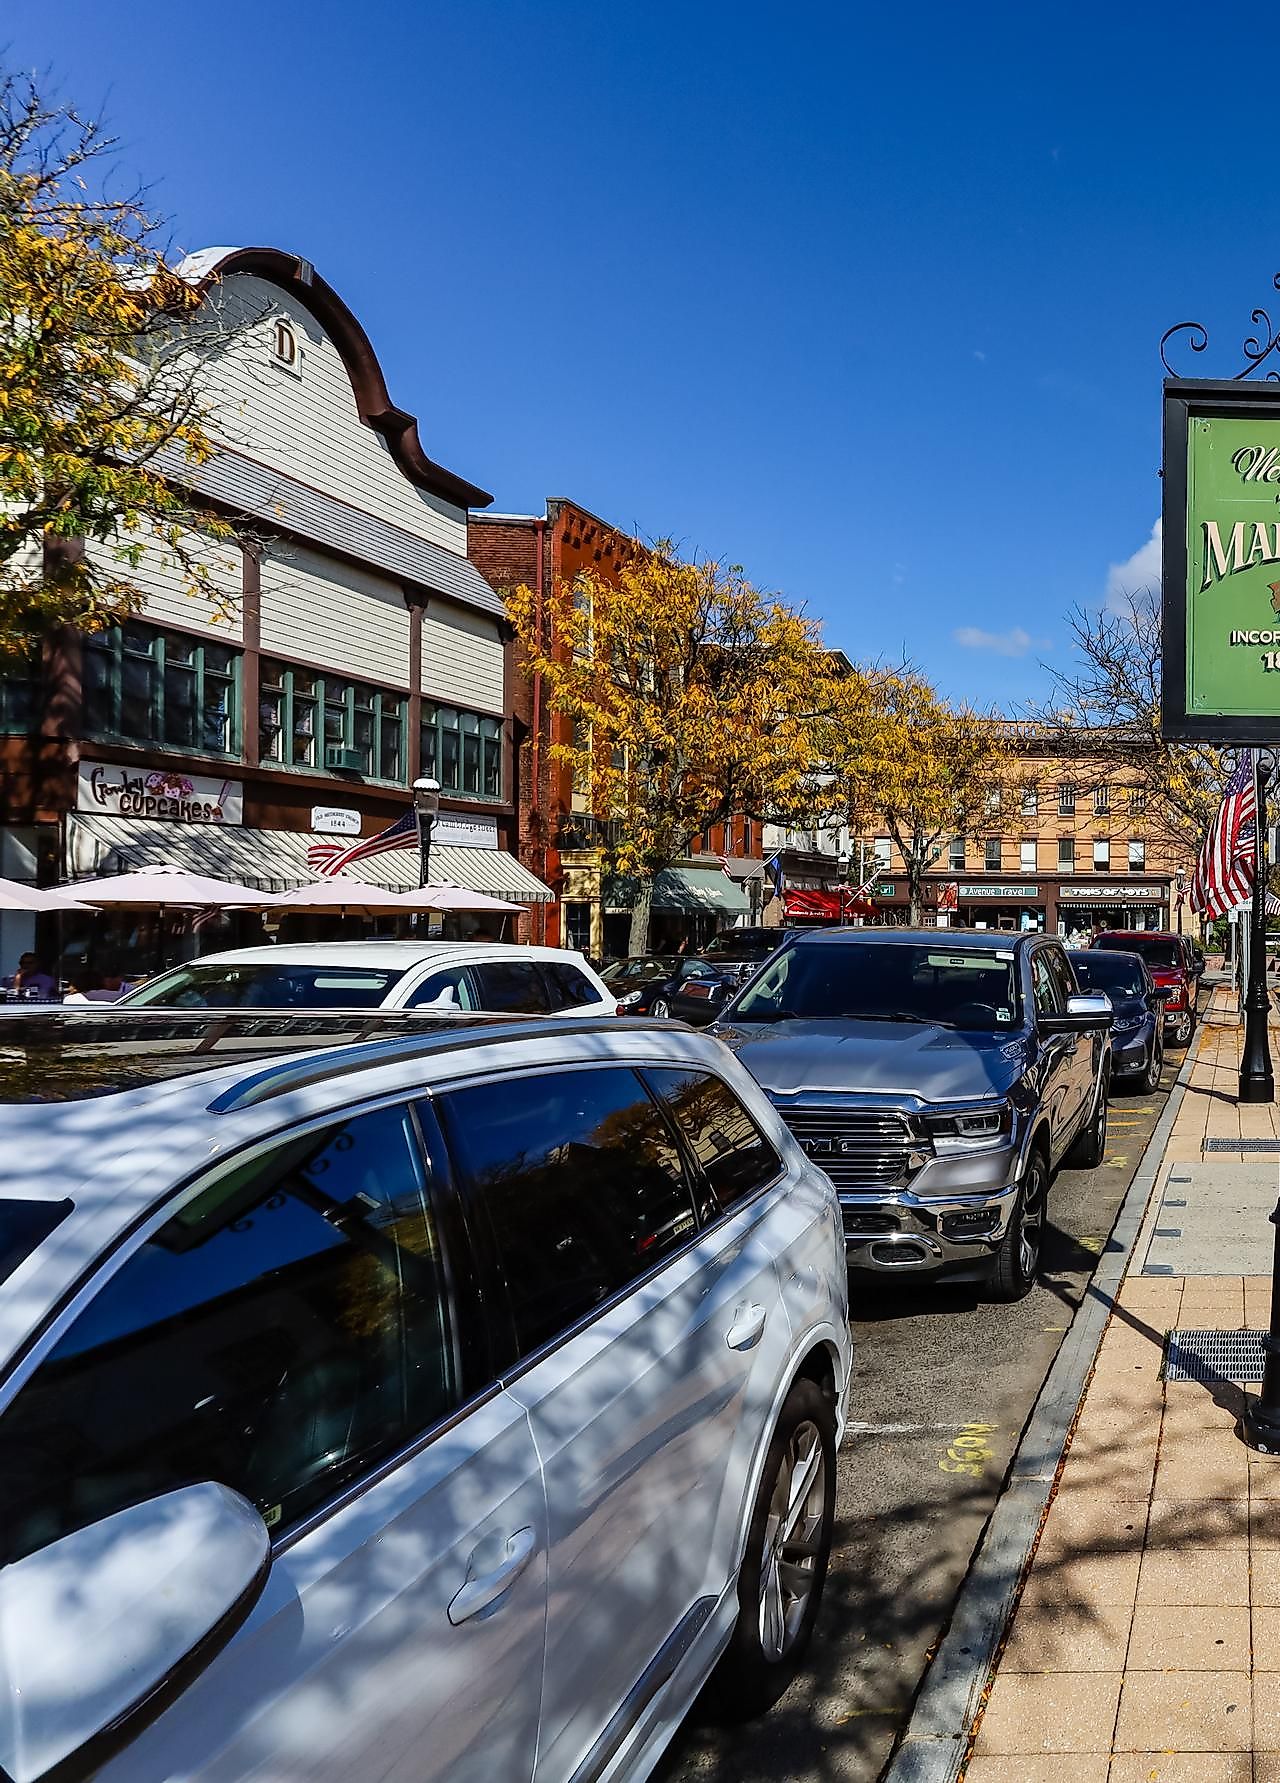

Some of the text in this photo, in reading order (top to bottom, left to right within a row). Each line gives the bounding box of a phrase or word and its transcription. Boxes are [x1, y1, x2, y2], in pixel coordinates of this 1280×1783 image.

[969, 887, 1024, 896] Avenue Travel
[1072, 888, 1101, 897] TONS
[1103, 888, 1118, 897] OF
